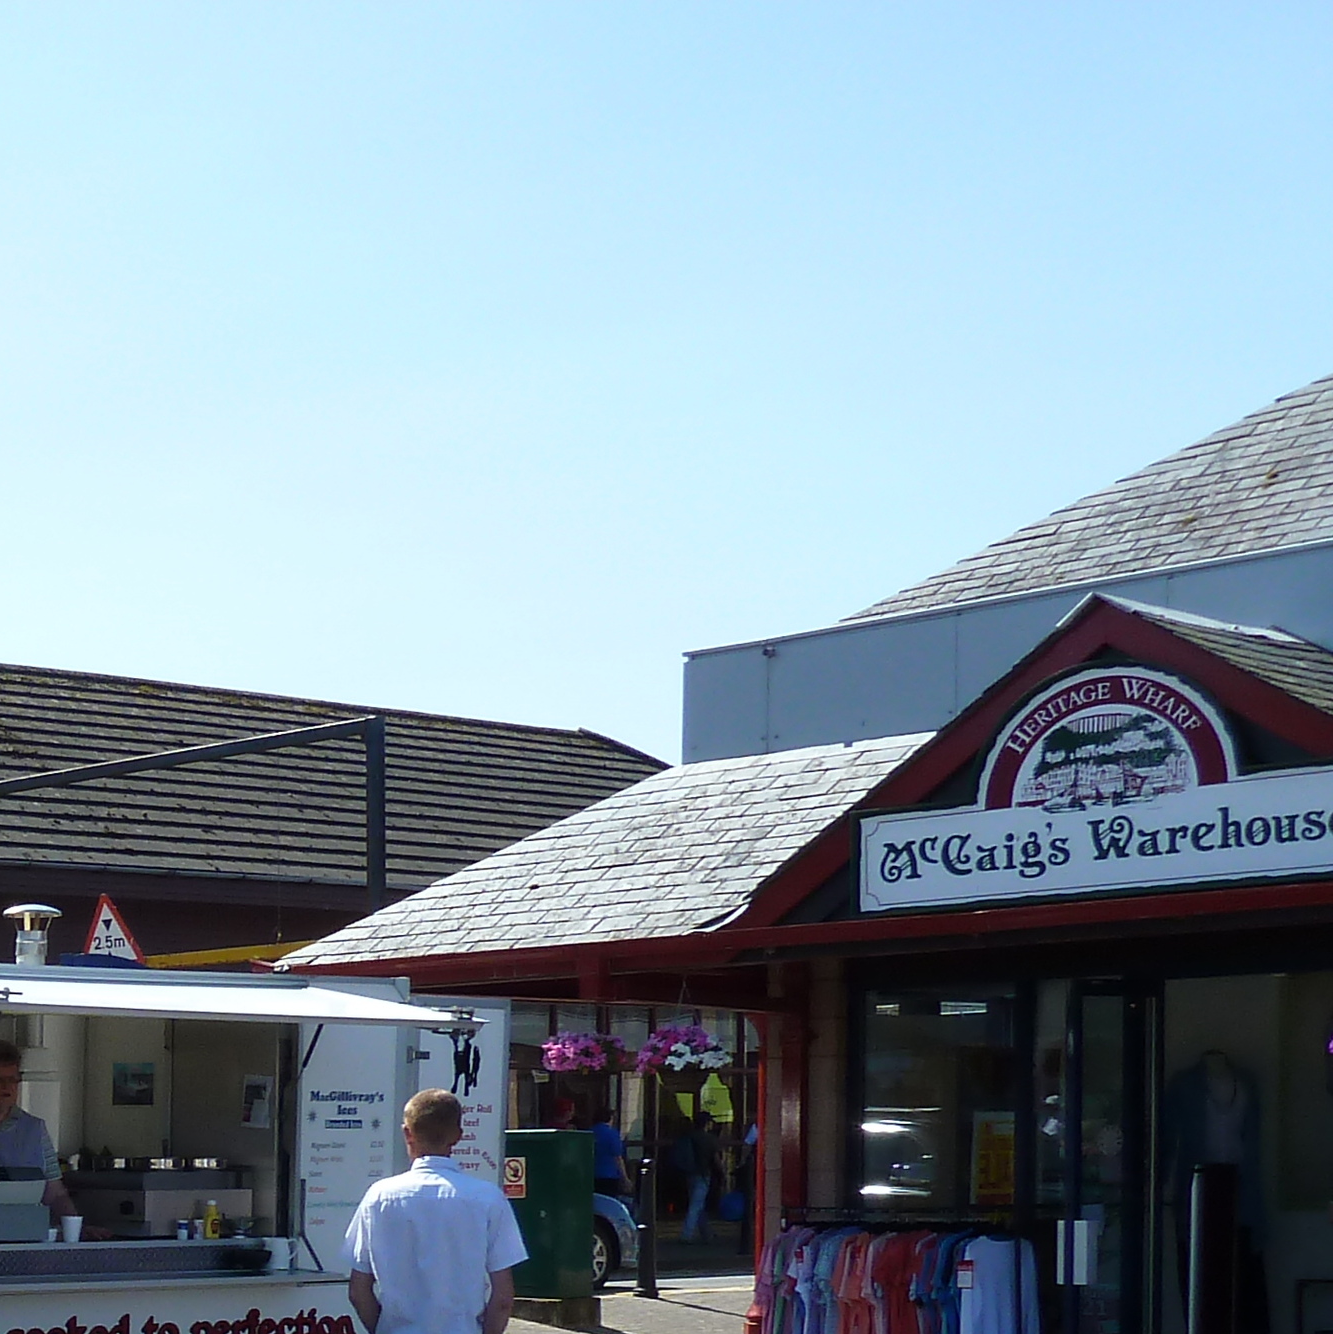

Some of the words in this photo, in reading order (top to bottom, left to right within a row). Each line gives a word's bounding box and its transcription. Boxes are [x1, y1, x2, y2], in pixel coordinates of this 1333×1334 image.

[1006, 683, 1111, 755] HERITAGE
[1121, 678, 1202, 731] WHARF
[880, 822, 1071, 883] McCaig's
[94, 935, 126, 950] 2.5m
[310, 1090, 385, 1105] MacGillivray's
[337, 1104, 358, 1115] Ices
